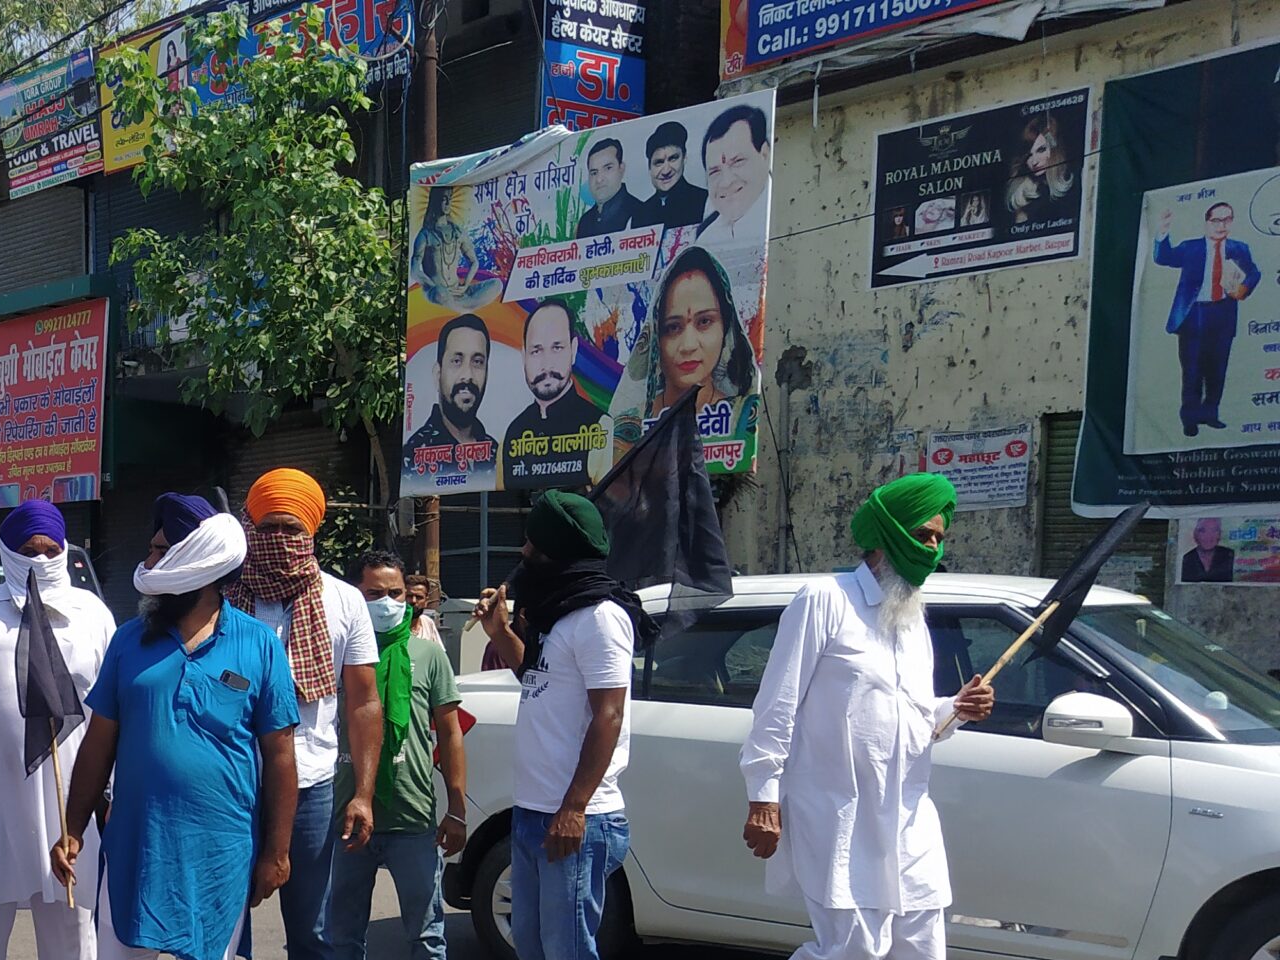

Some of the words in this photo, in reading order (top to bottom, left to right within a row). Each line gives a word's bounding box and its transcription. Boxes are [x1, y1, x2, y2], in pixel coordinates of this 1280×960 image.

[580, 18, 609, 47] केयर
[40, 76, 61, 93] GROUP
[51, 124, 99, 152] TRAVEL
[885, 164, 927, 185] ROYAL
[931, 150, 1002, 178] MADONNA
[918, 177, 963, 197] SALON
[1011, 223, 1029, 235] Only
[1031, 220, 1045, 231] For
[1047, 217, 1073, 228] Ladies
[586, 236, 614, 259] होली,
[968, 251, 986, 263] Road
[987, 247, 1013, 262] Kapoor
[525, 267, 540, 289] की
[543, 266, 577, 288] हार्दिक
[22, 333, 66, 384] मोबाईल
[70, 330, 99, 374] केयर
[13, 393, 38, 416] प्रकार
[40, 386, 51, 408] के
[43, 412, 58, 437] की
[60, 409, 86, 434] जाती
[88, 407, 97, 433] है
[697, 402, 731, 436] देवी
[509, 430, 550, 458] अनिल
[553, 423, 608, 453] वाल्मीकि
[414, 443, 453, 475] मुकुन्द
[455, 440, 493, 471] शुक्ला
[512, 462, 528, 476] मो.
[531, 460, 583, 476] 9927648728
